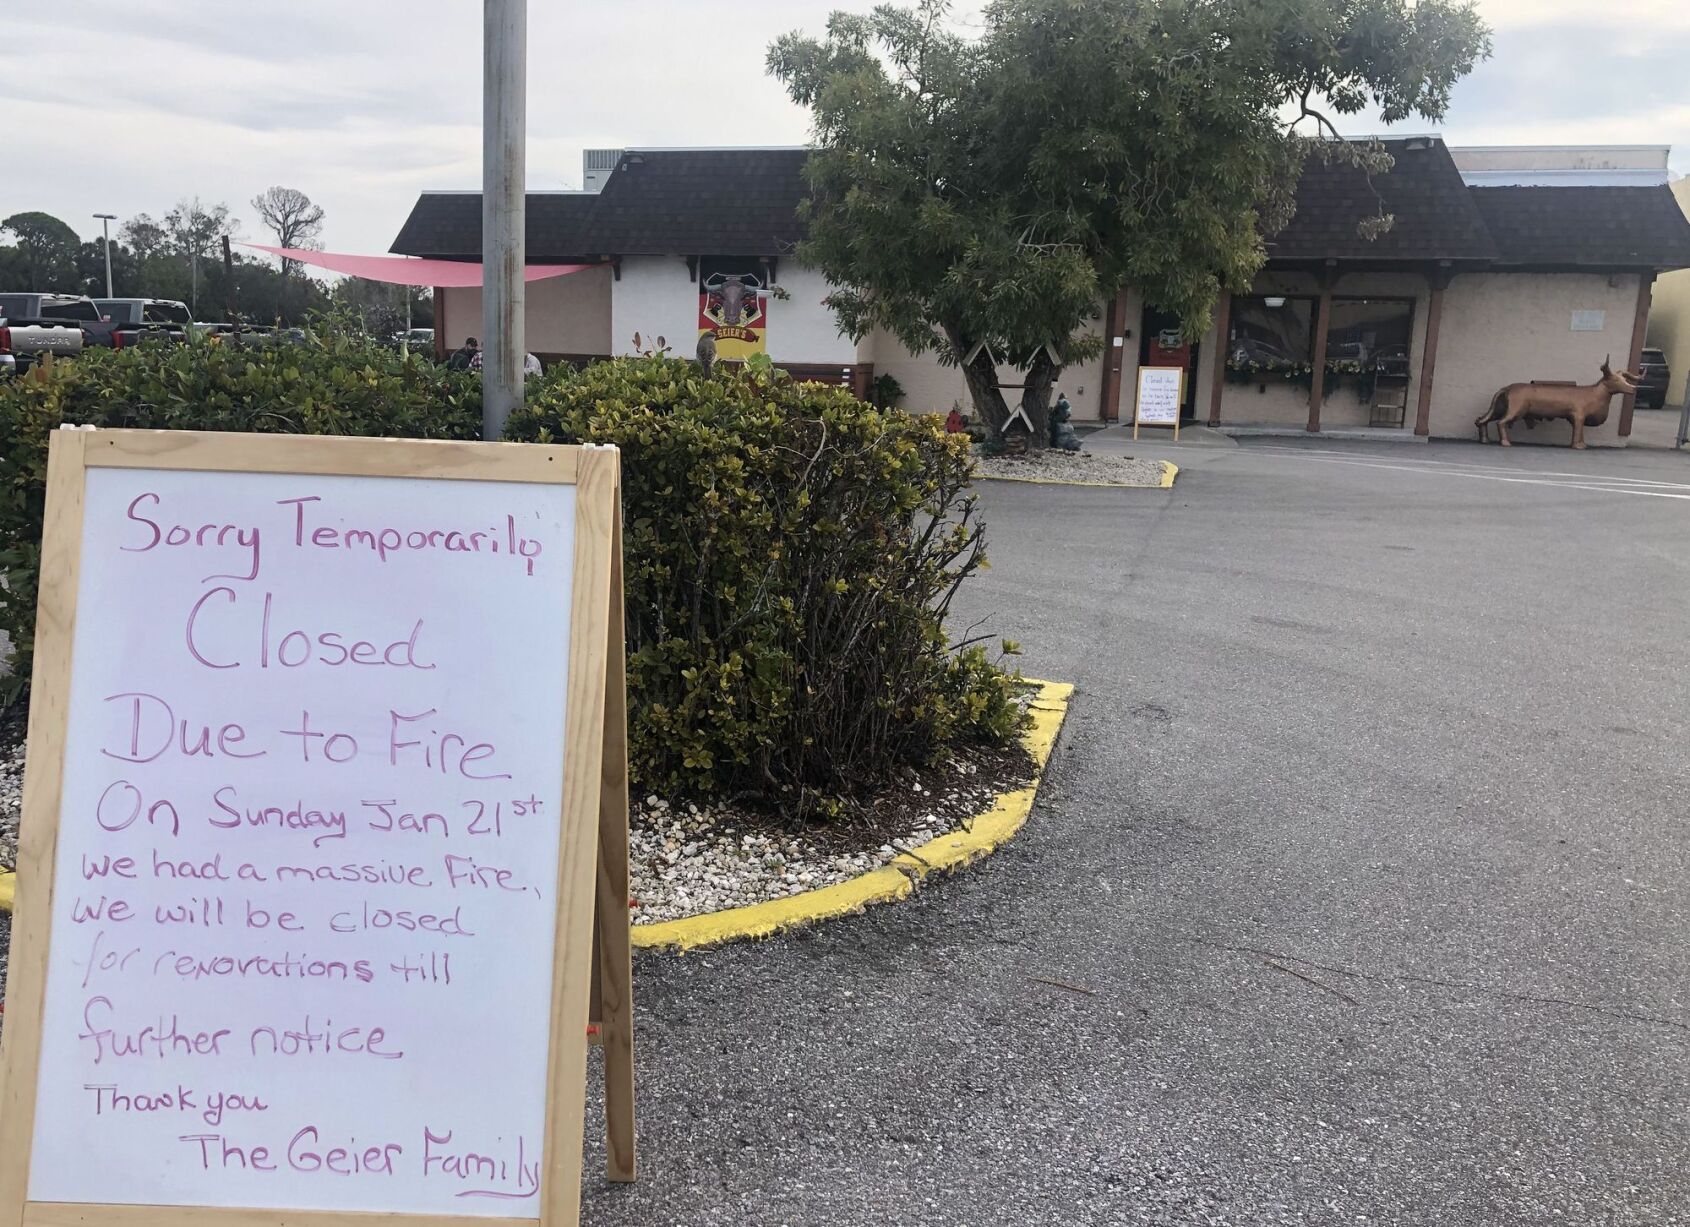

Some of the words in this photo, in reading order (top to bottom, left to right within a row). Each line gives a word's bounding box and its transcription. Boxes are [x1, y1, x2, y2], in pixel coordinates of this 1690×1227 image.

[28, 336, 70, 345] TUNDRA
[120, 492, 260, 584] Sorry
[186, 586, 437, 669] Closed
[100, 692, 267, 764] Due
[280, 709, 359, 763] to
[390, 707, 513, 779] Fire
[97, 780, 180, 837] On
[208, 787, 347, 848] Sunday
[361, 799, 449, 838] Jan
[462, 793, 544, 838] 21st
[152, 848, 230, 881] had
[237, 863, 268, 882] a
[275, 862, 433, 887] massive
[154, 897, 224, 927] will
[246, 899, 305, 932] be
[329, 901, 476, 937] closed
[72, 930, 141, 988] for
[390, 951, 451, 985] till
[79, 996, 232, 1065] further
[250, 1015, 404, 1059] notice
[83, 1084, 198, 1115] Thank
[202, 1091, 270, 1126] you
[178, 1134, 278, 1171] The
[287, 1125, 403, 1177] Geier
[423, 1125, 541, 1198] Family
